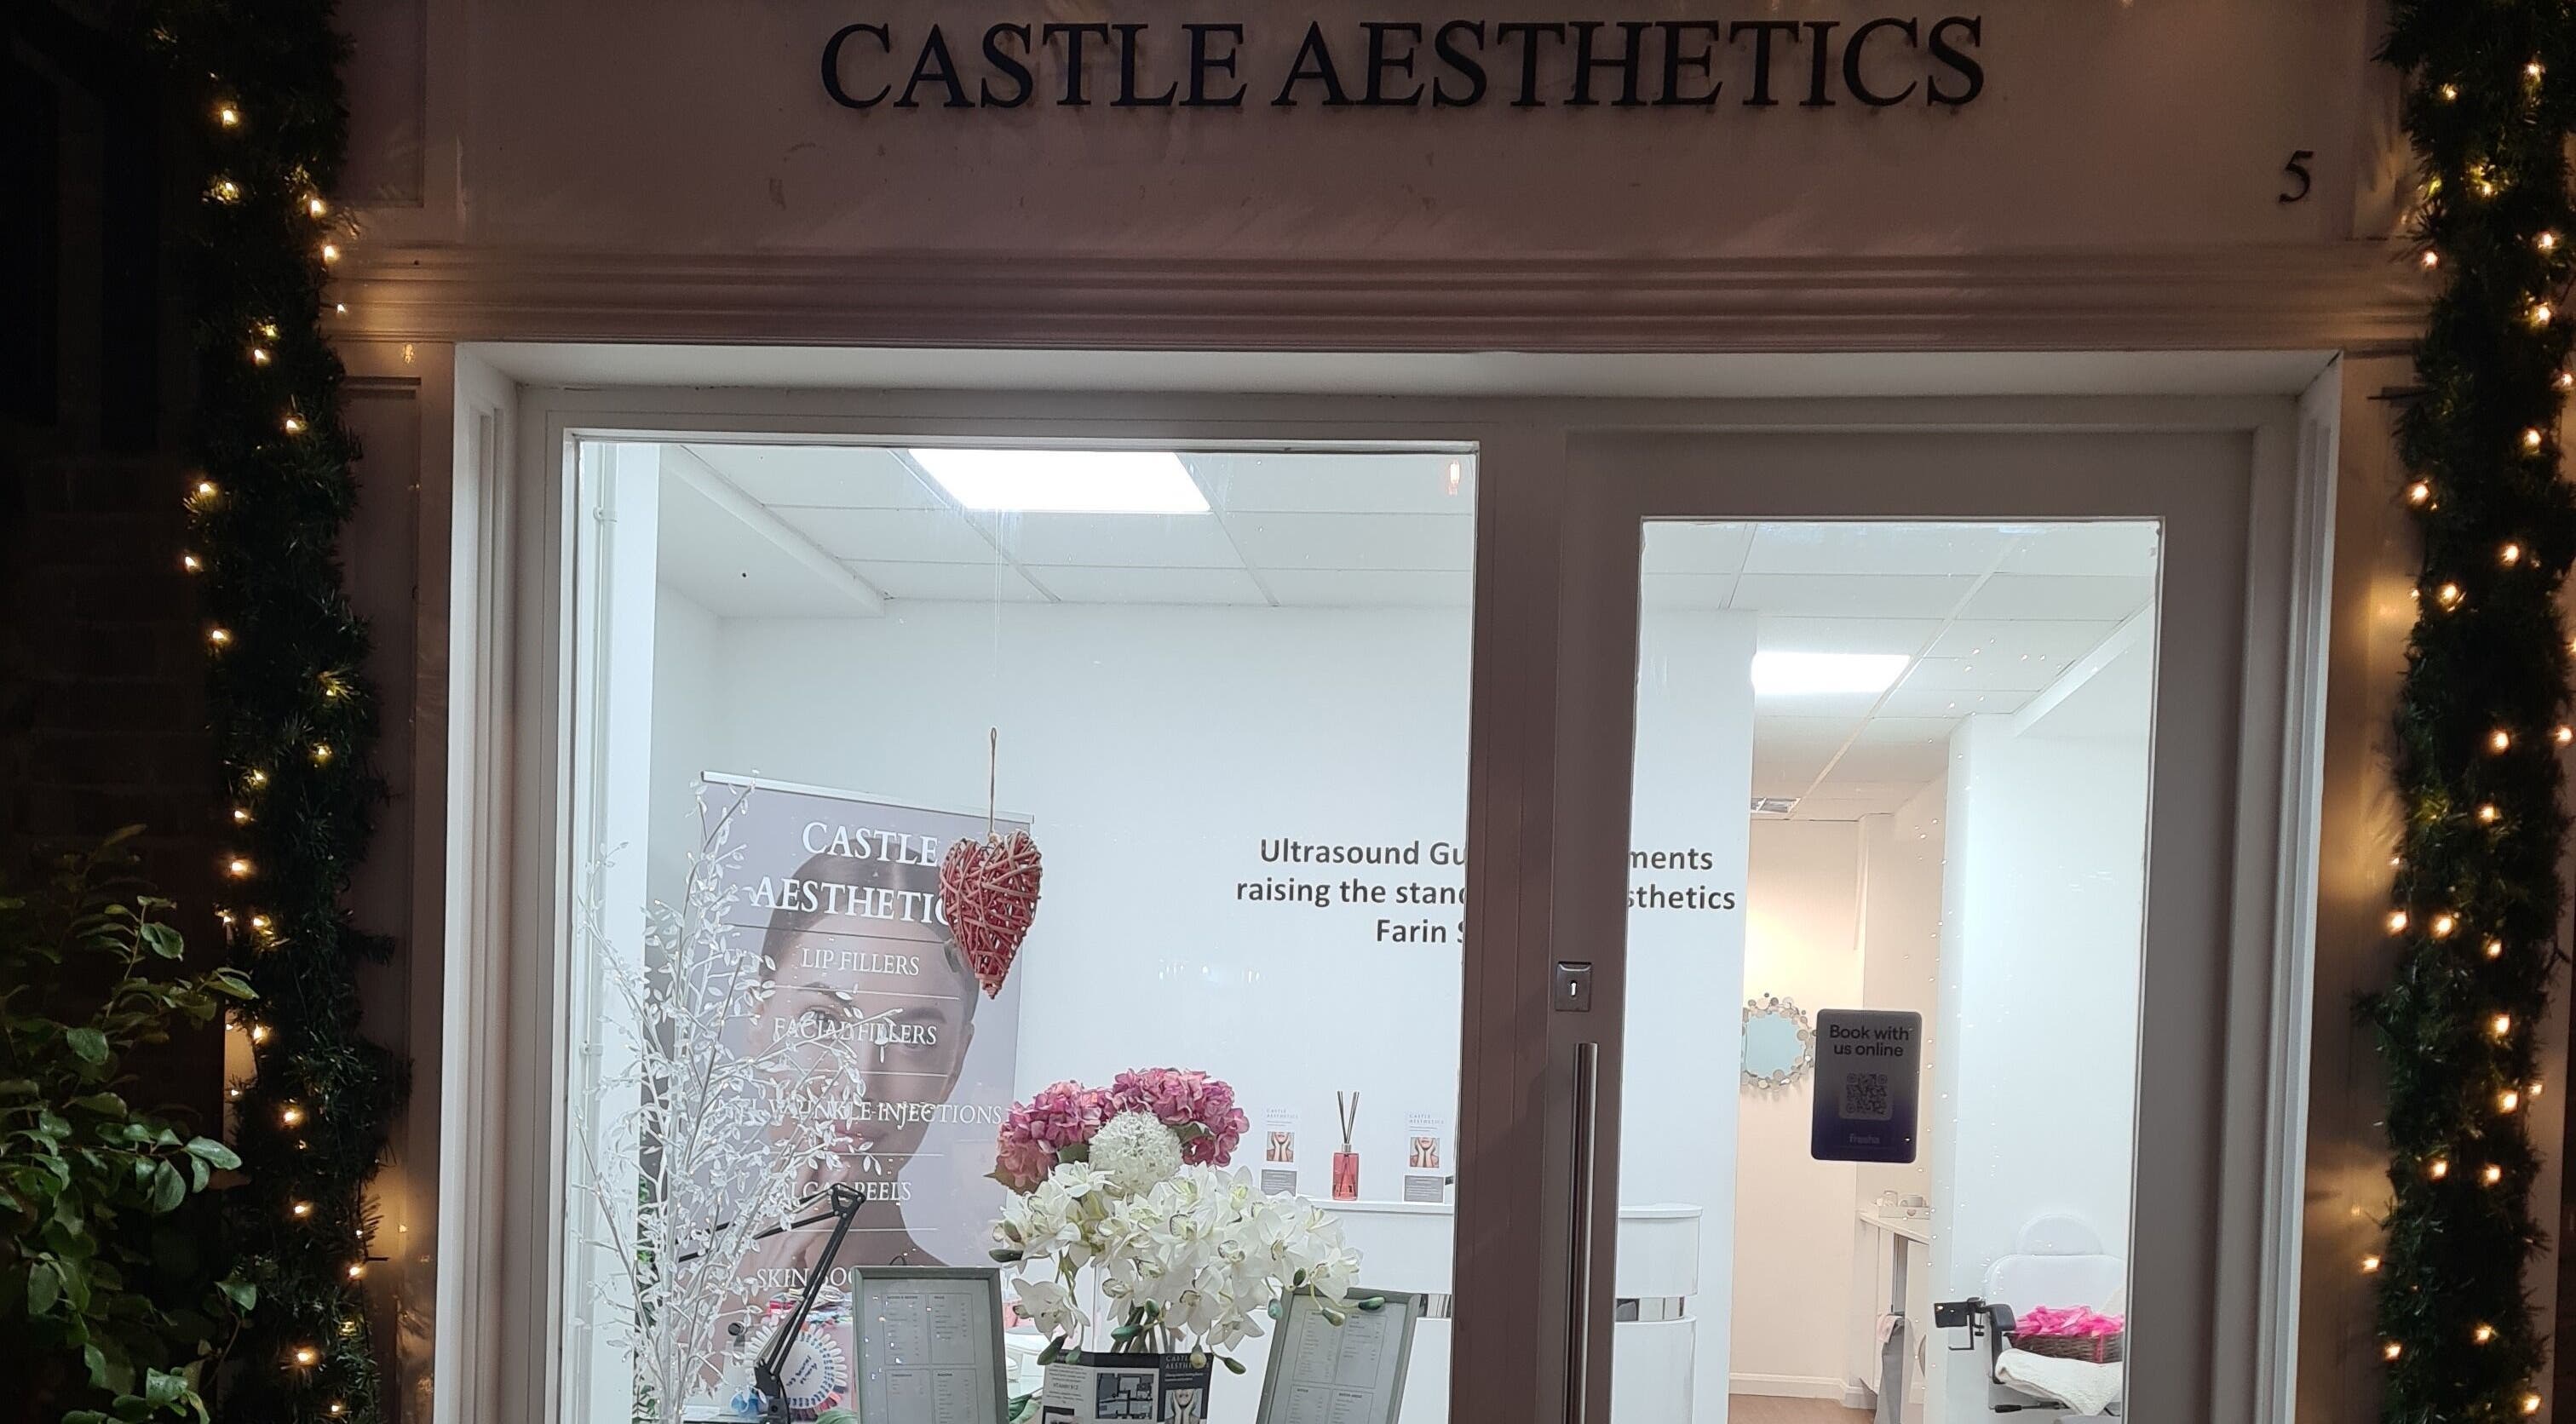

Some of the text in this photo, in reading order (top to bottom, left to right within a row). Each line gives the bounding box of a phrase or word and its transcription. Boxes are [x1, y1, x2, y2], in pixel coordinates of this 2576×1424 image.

[820, 15, 1985, 109] CASTLE AESTHETICS
[2278, 150, 2314, 204] 5
[802, 821, 938, 867] CASTLE
[1261, 838, 1713, 870] Ultrasound Gu ments
[750, 876, 954, 926] AESTHETIC
[1237, 877, 1735, 910] raising the stan sthetics
[1377, 919, 1447, 944] Farin
[801, 947, 920, 976] LIP FILLERS
[858, 1022, 937, 1046] FILLERS
[1830, 1025, 1909, 1041] Book with
[1834, 1042, 1904, 1057] us online
[878, 1100, 1002, 1130] INJECTIONS
[854, 1181, 911, 1202] PEELS
[756, 1267, 809, 1289] SKIN
